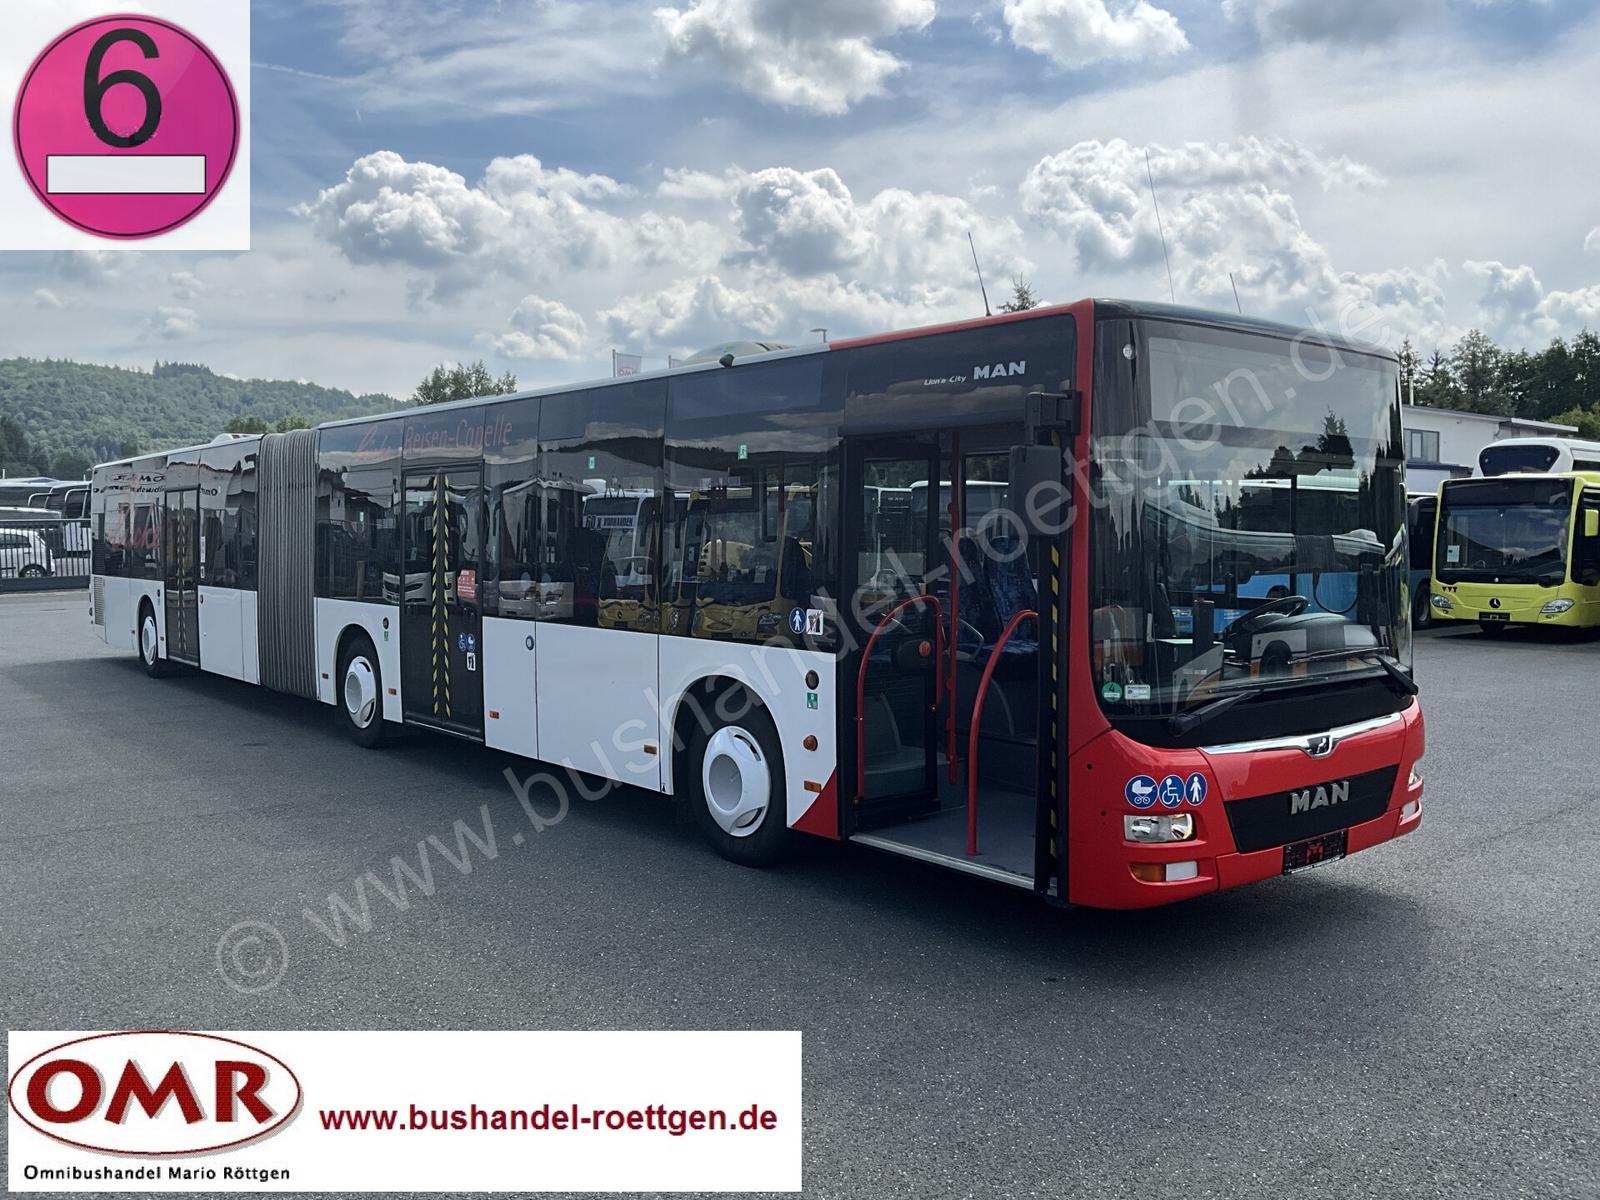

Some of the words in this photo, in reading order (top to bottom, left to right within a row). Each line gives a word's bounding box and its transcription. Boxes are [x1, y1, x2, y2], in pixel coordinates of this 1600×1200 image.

[949, 375, 967, 383] City
[974, 360, 1026, 380] MAN
[1290, 780, 1350, 815] MAN
